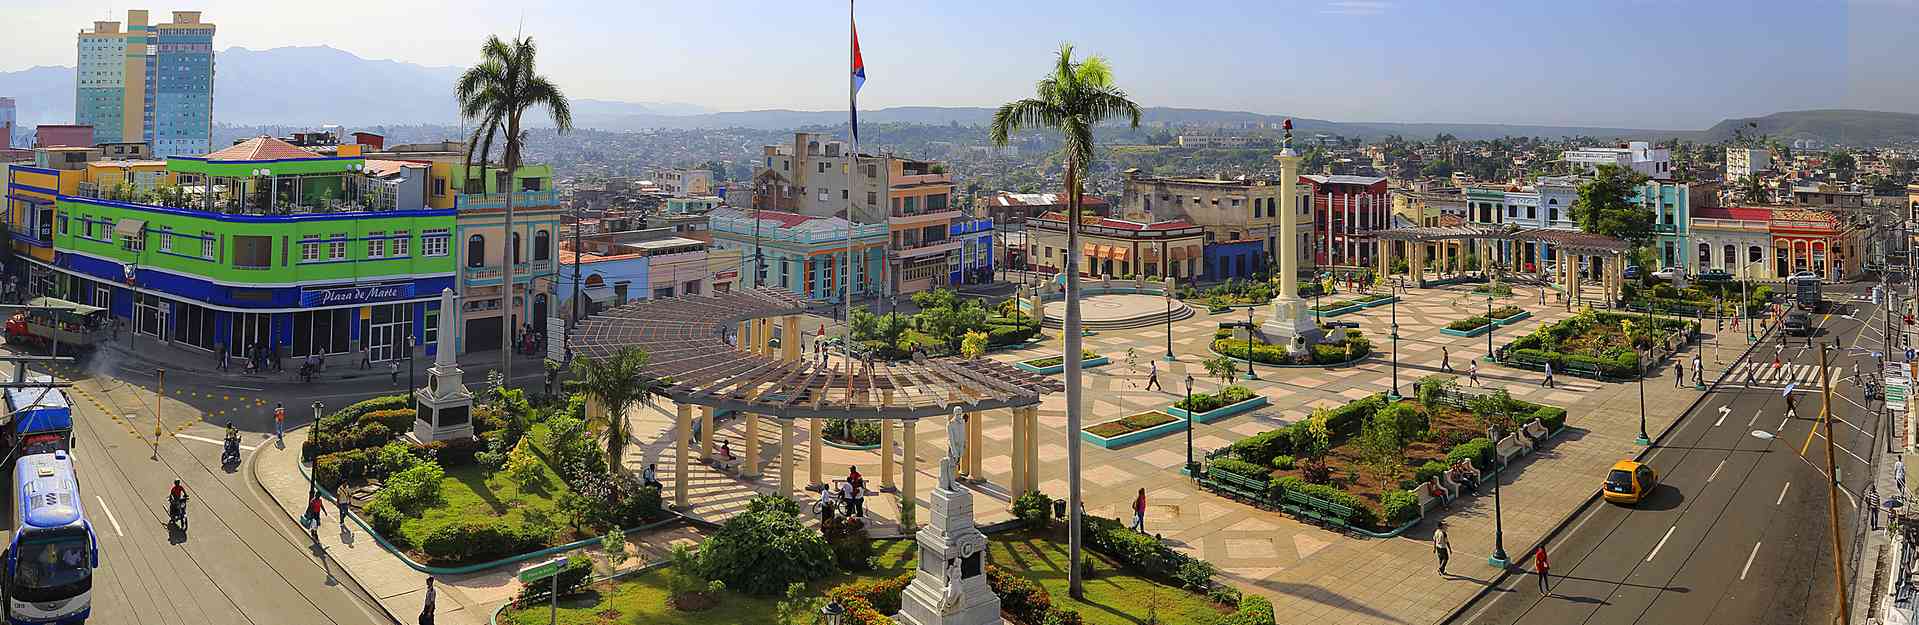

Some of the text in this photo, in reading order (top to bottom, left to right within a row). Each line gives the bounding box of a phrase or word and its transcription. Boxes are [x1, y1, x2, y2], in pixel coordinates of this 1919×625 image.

[322, 287, 397, 304] Plaza de Marte
